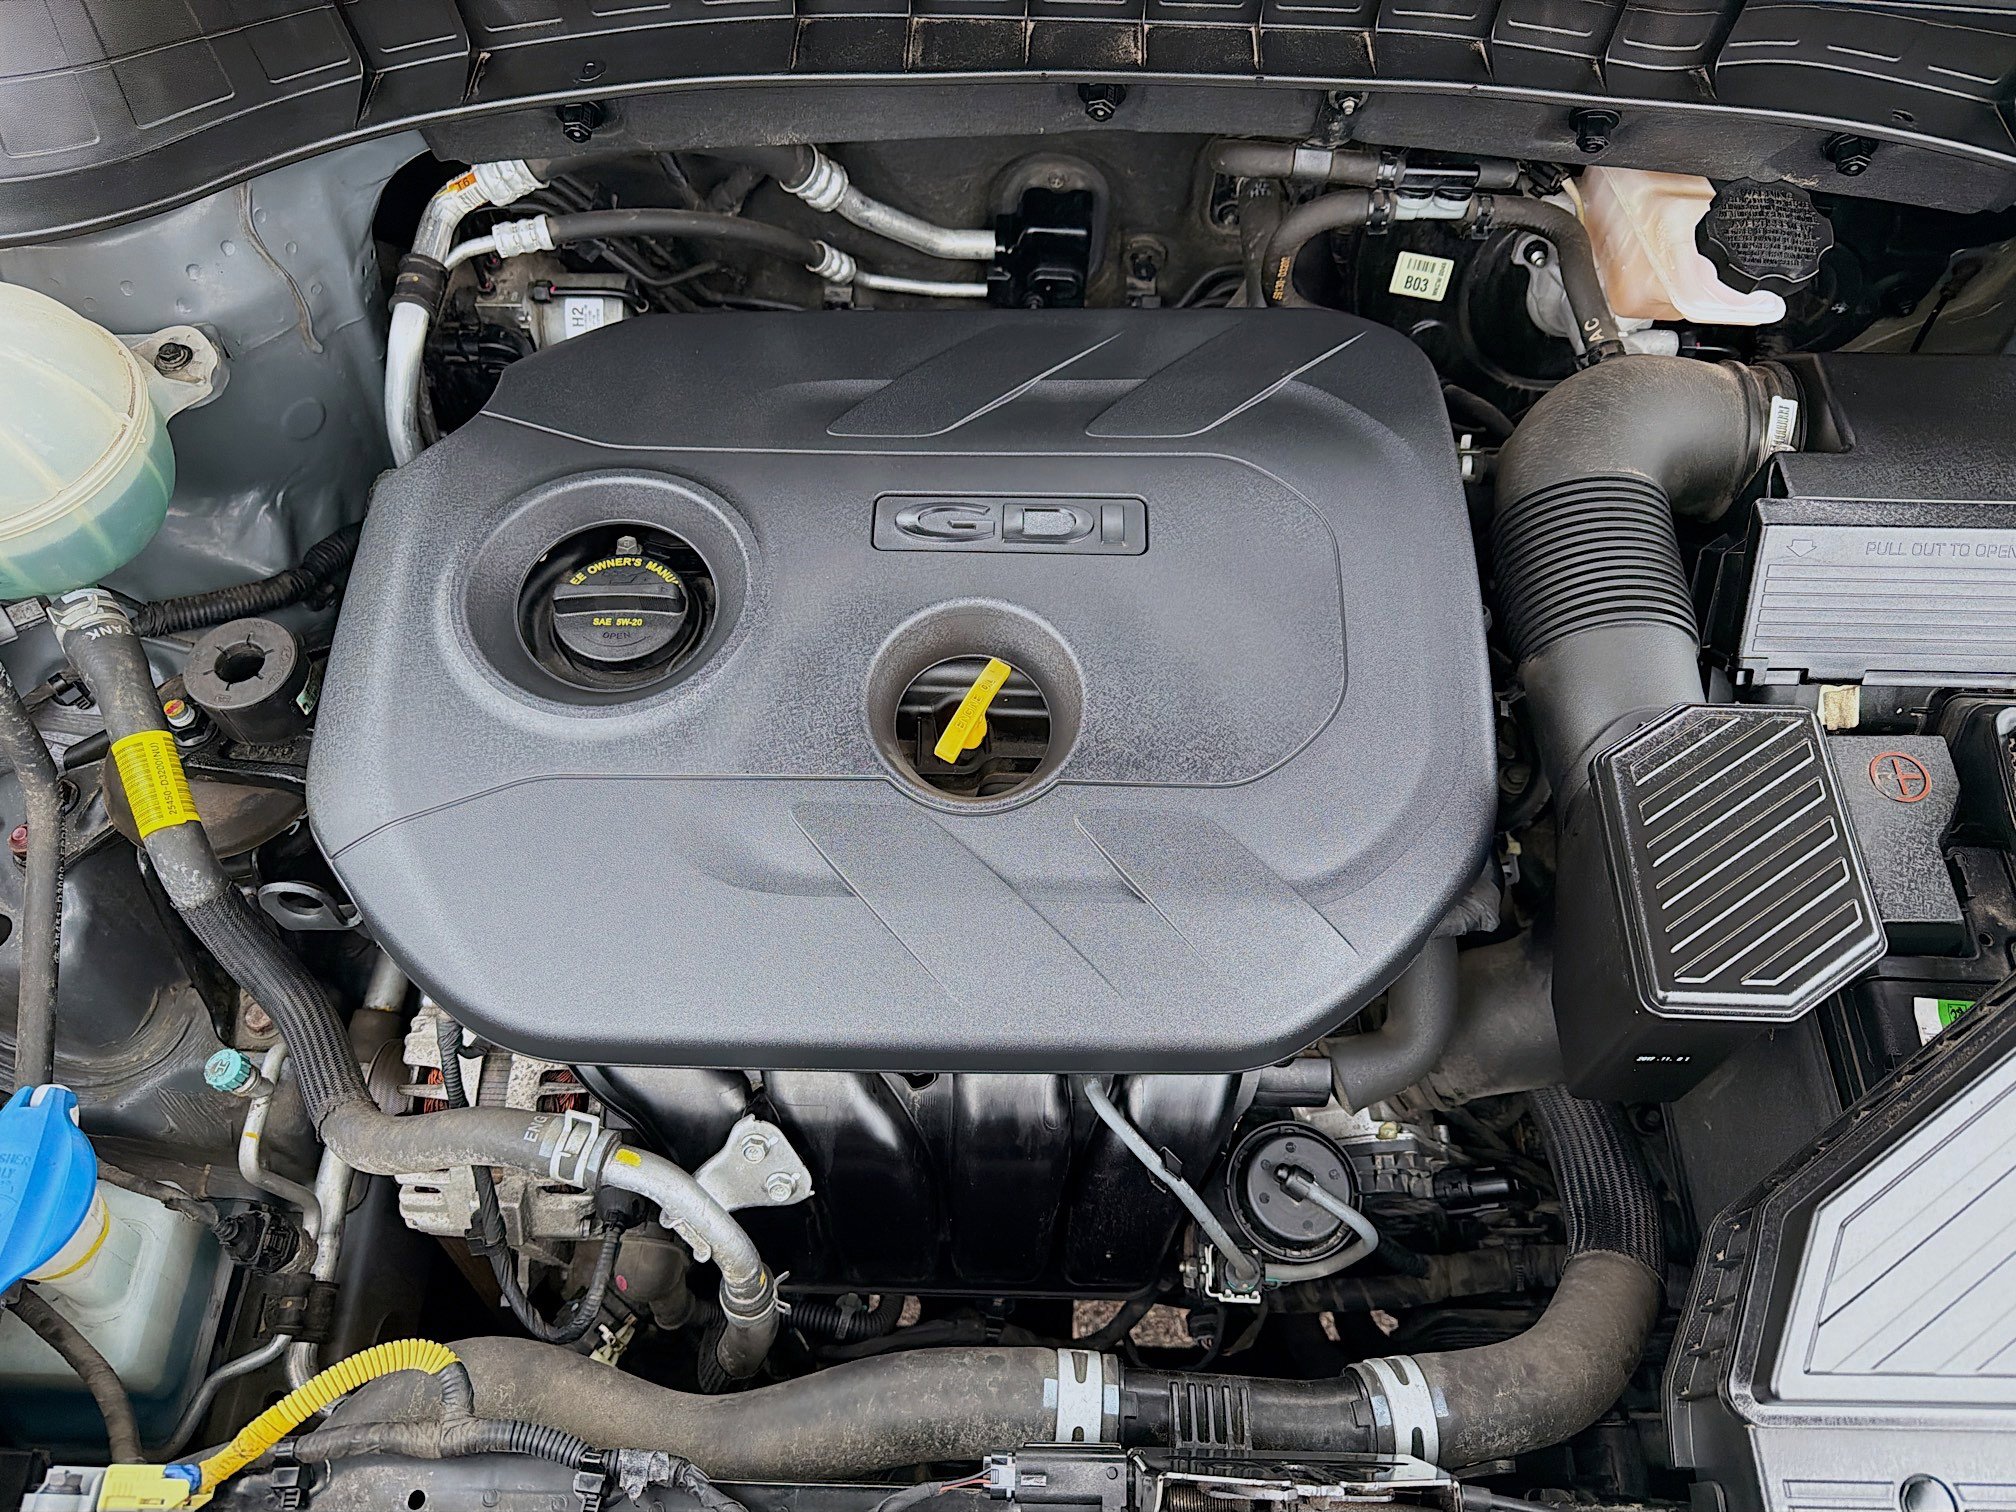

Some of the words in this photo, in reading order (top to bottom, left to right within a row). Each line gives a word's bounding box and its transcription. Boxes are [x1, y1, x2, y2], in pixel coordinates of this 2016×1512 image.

[1404, 275, 1429, 292] B03
[572, 307, 584, 327] H2
[1584, 318, 1605, 342] AC
[894, 501, 1126, 547] GDI
[1866, 541, 1906, 556] PULL
[1912, 542, 1947, 557] OUT
[1950, 542, 1971, 557] TO
[570, 572, 587, 586] EE
[587, 557, 643, 575] OWNER'S
[645, 560, 683, 588] MANU
[592, 617, 612, 627] SAE
[616, 617, 643, 627] 5W-20
[85, 624, 135, 641] TANK
[602, 631, 631, 640] OPEN
[956, 695, 983, 730] ENGINE
[981, 679, 996, 692] OIL
[523, 1115, 549, 1143] ENG
